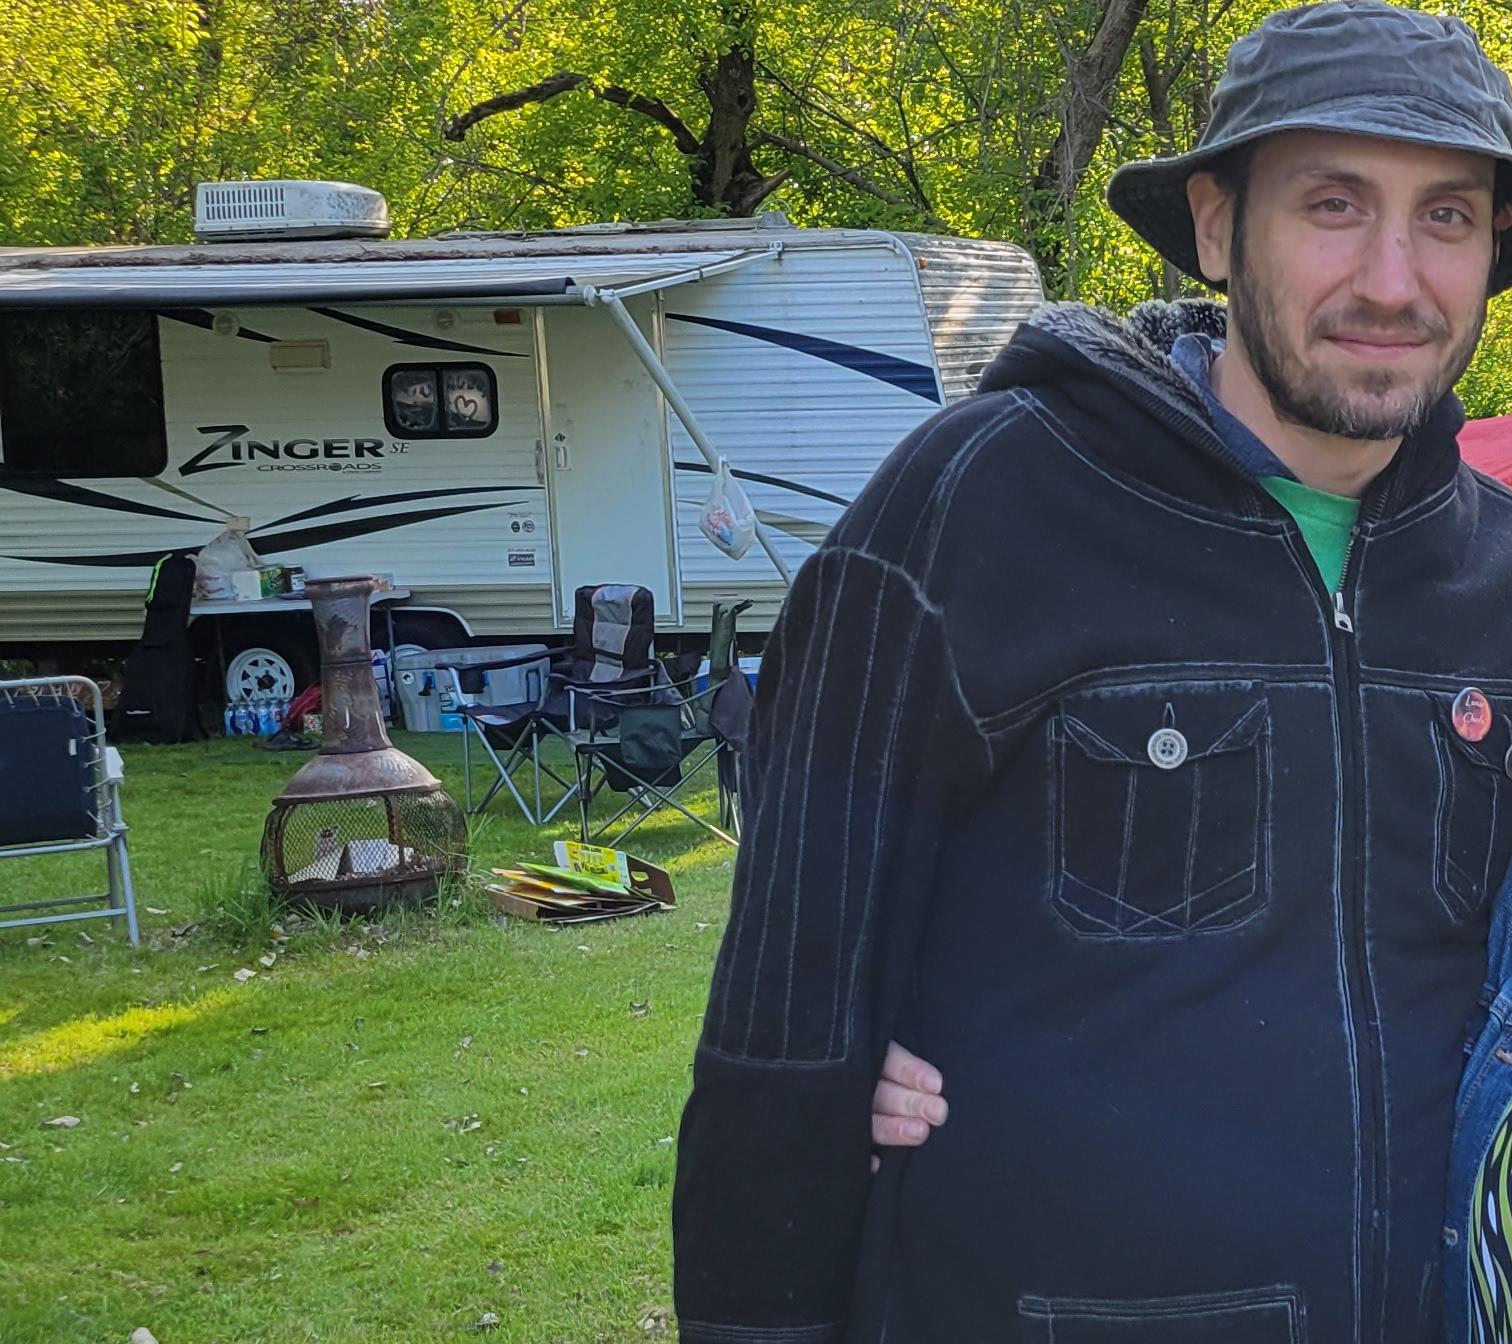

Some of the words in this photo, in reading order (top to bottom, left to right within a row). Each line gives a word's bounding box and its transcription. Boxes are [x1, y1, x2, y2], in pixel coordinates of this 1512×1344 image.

[178, 424, 386, 477] ZINGER
[389, 442, 411, 454] SE
[256, 462, 383, 472] CROSSROADS
